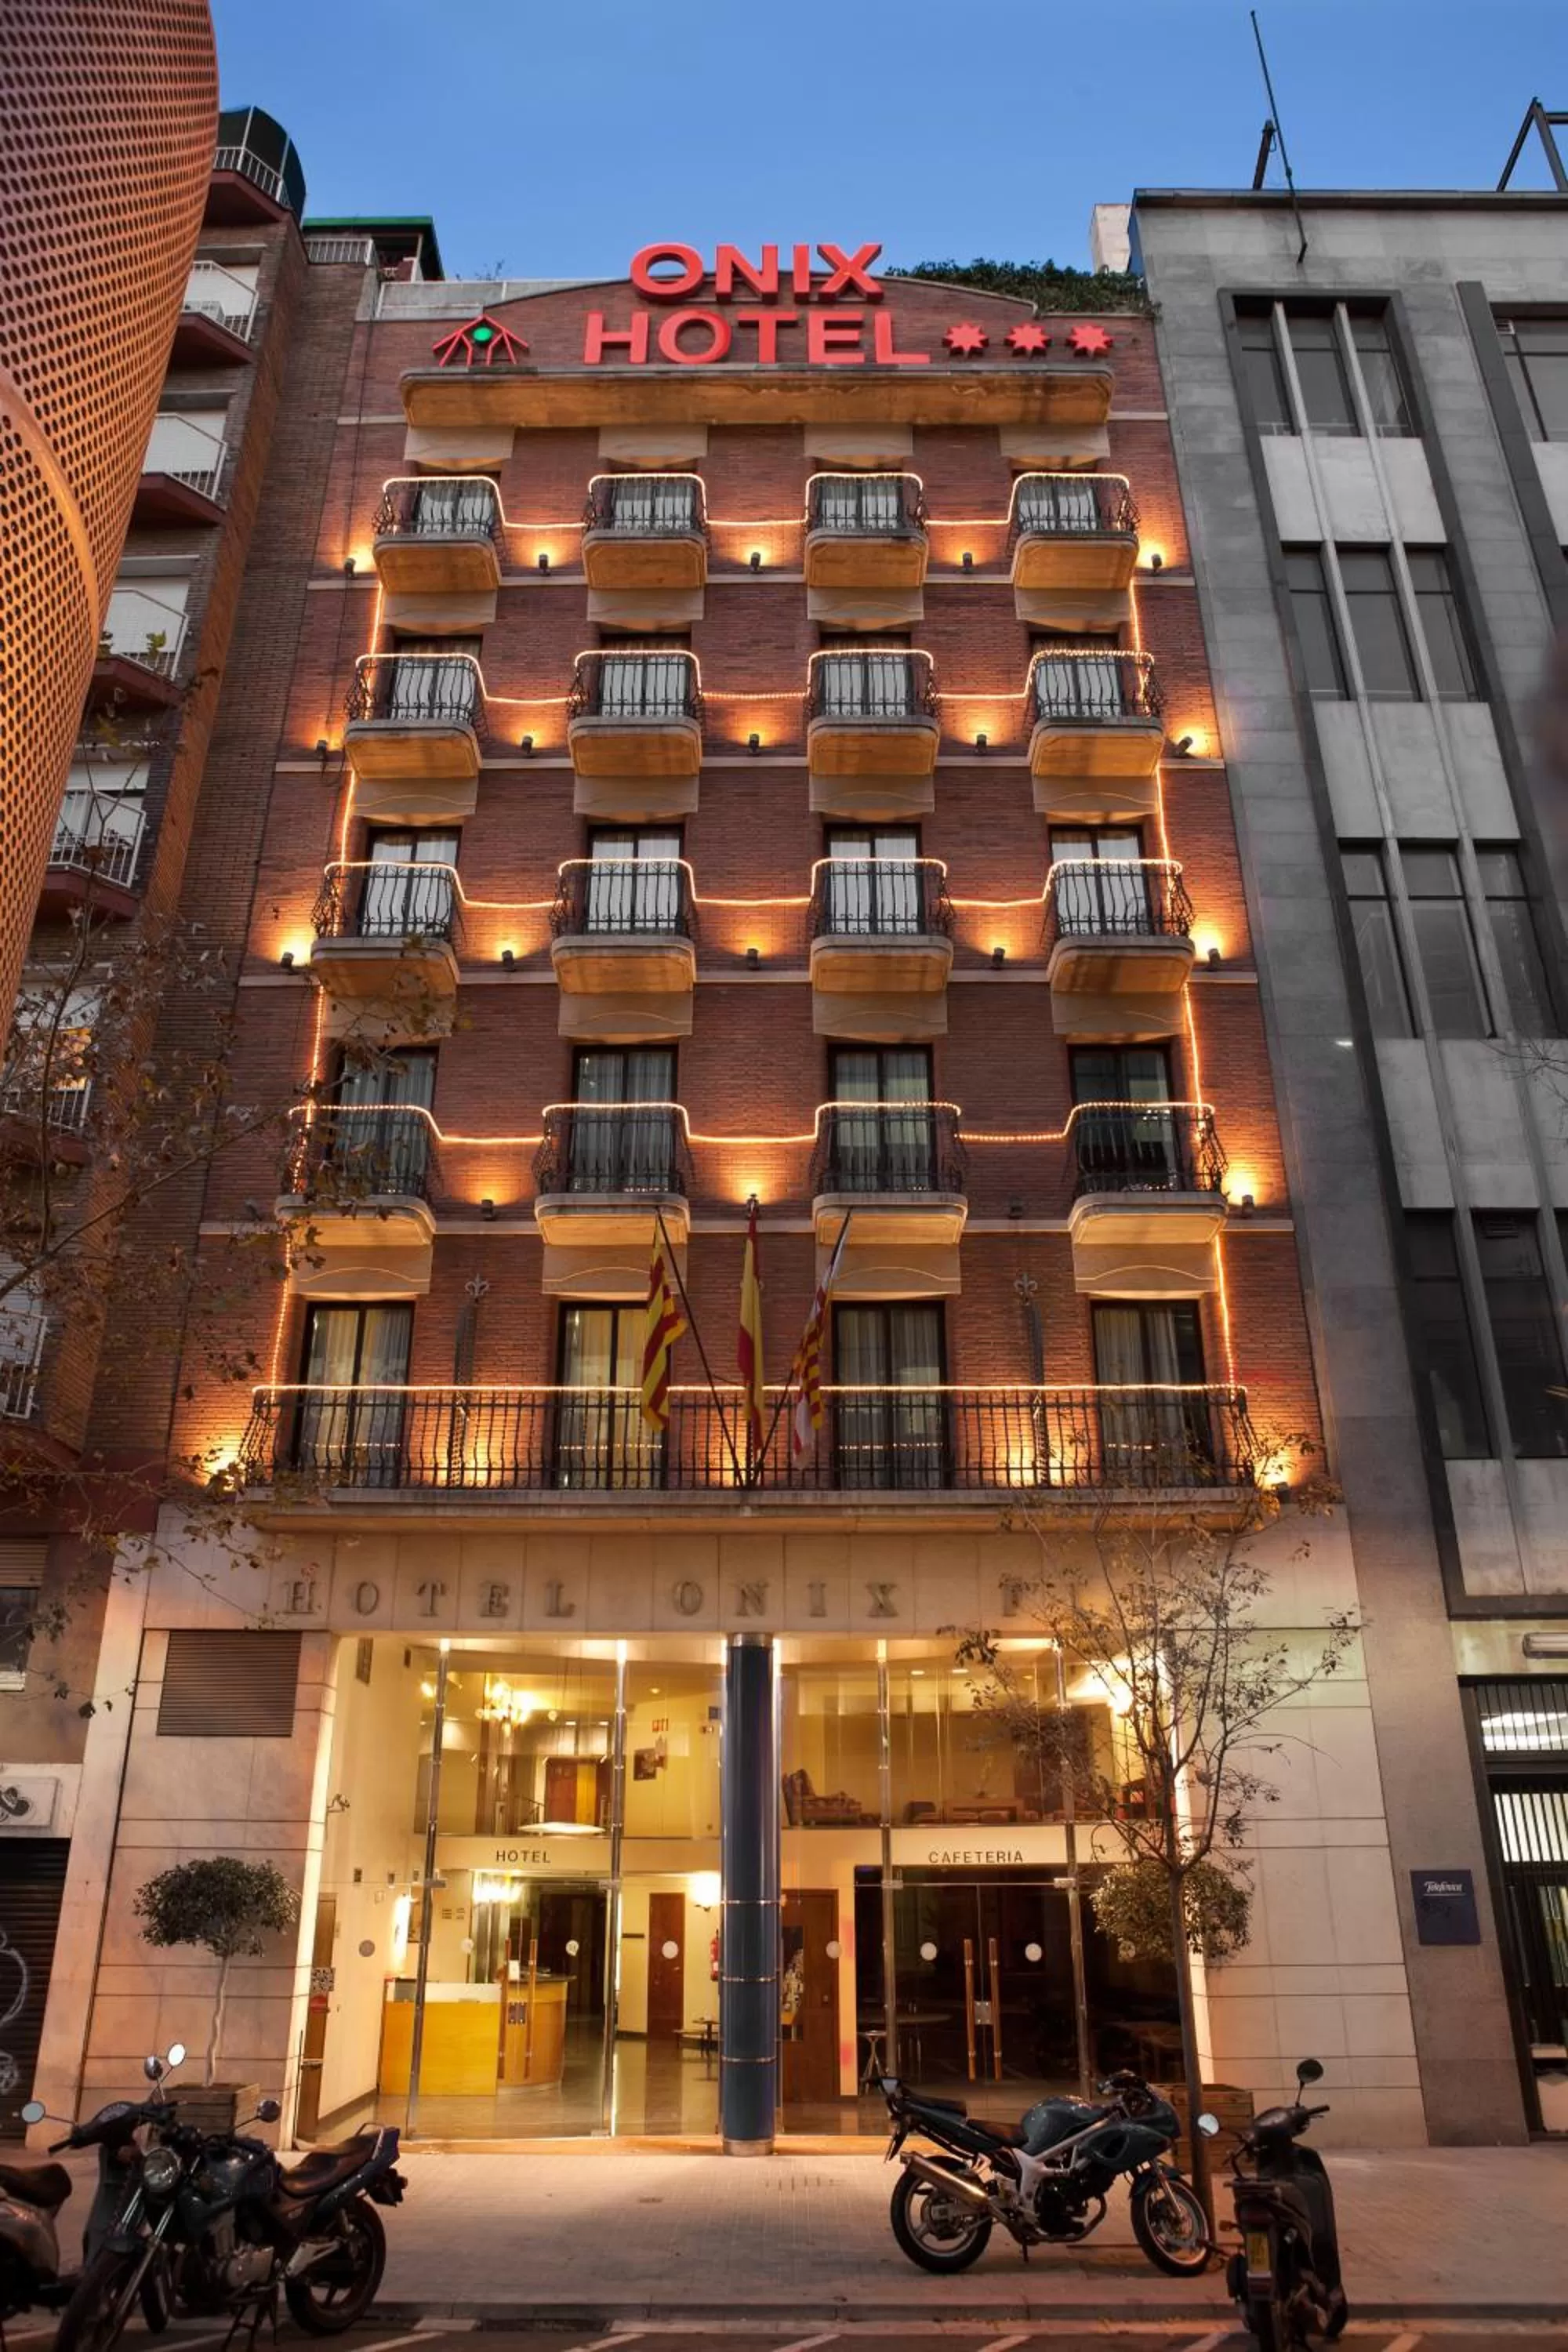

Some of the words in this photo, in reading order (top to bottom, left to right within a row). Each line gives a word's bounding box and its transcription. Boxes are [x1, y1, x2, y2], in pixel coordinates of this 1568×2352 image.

[630, 241, 884, 303] ONIX
[583, 309, 931, 365] HOTEL
[283, 1580, 576, 1617] HOTEL
[671, 1580, 897, 1617] ONIX
[495, 1849, 551, 1864] HOTEL
[928, 1849, 1024, 1864] CAFETERIA
